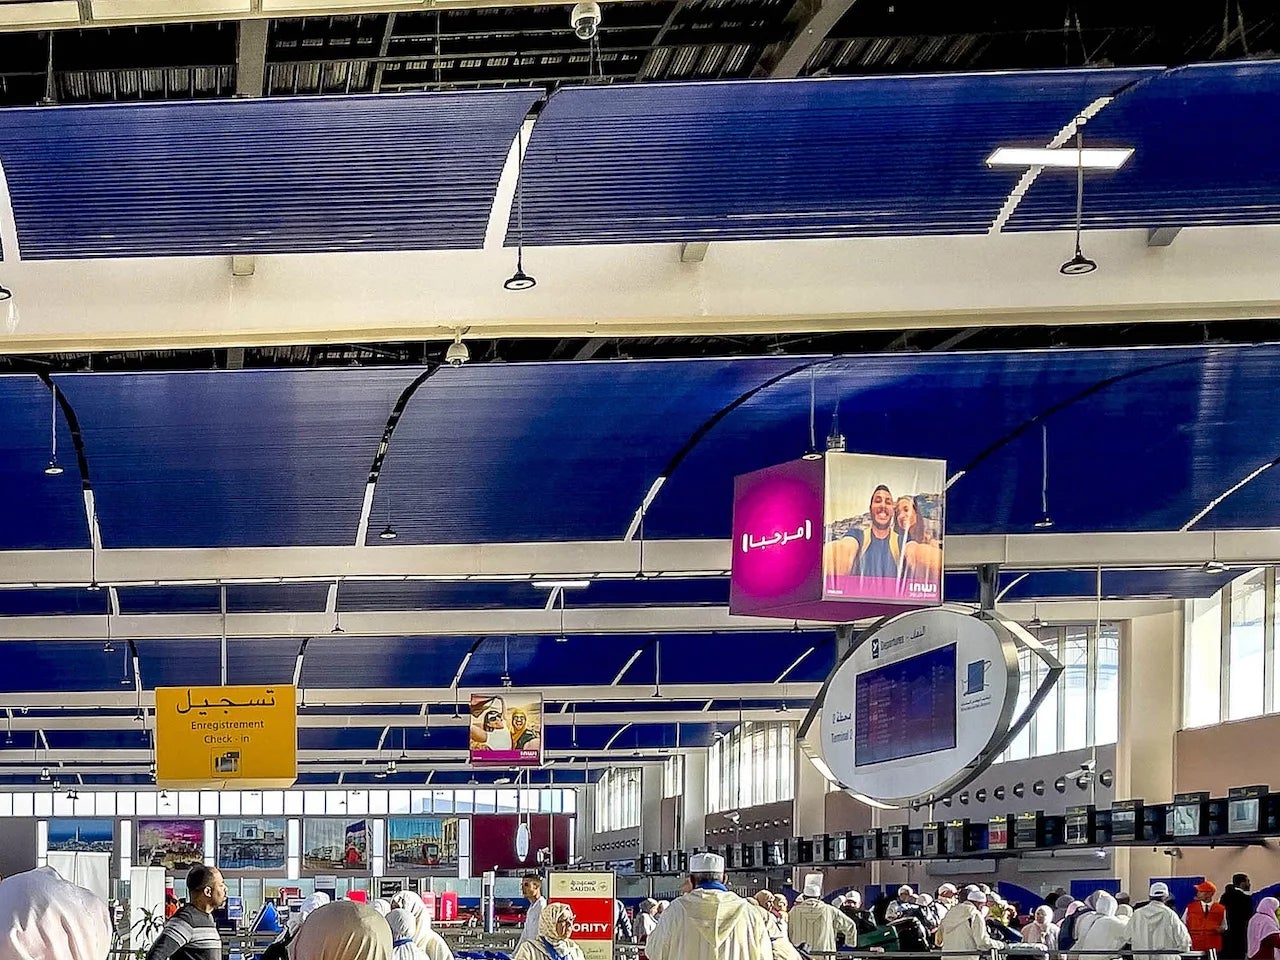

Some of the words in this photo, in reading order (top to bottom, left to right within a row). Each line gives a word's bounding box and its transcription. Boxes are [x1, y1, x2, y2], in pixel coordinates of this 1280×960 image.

[176, 689, 275, 715] تسجيل
[191, 720, 264, 731] Enregistrement
[204, 734, 233, 744] Check
[240, 734, 250, 743] in
[573, 923, 609, 932] ORITY
